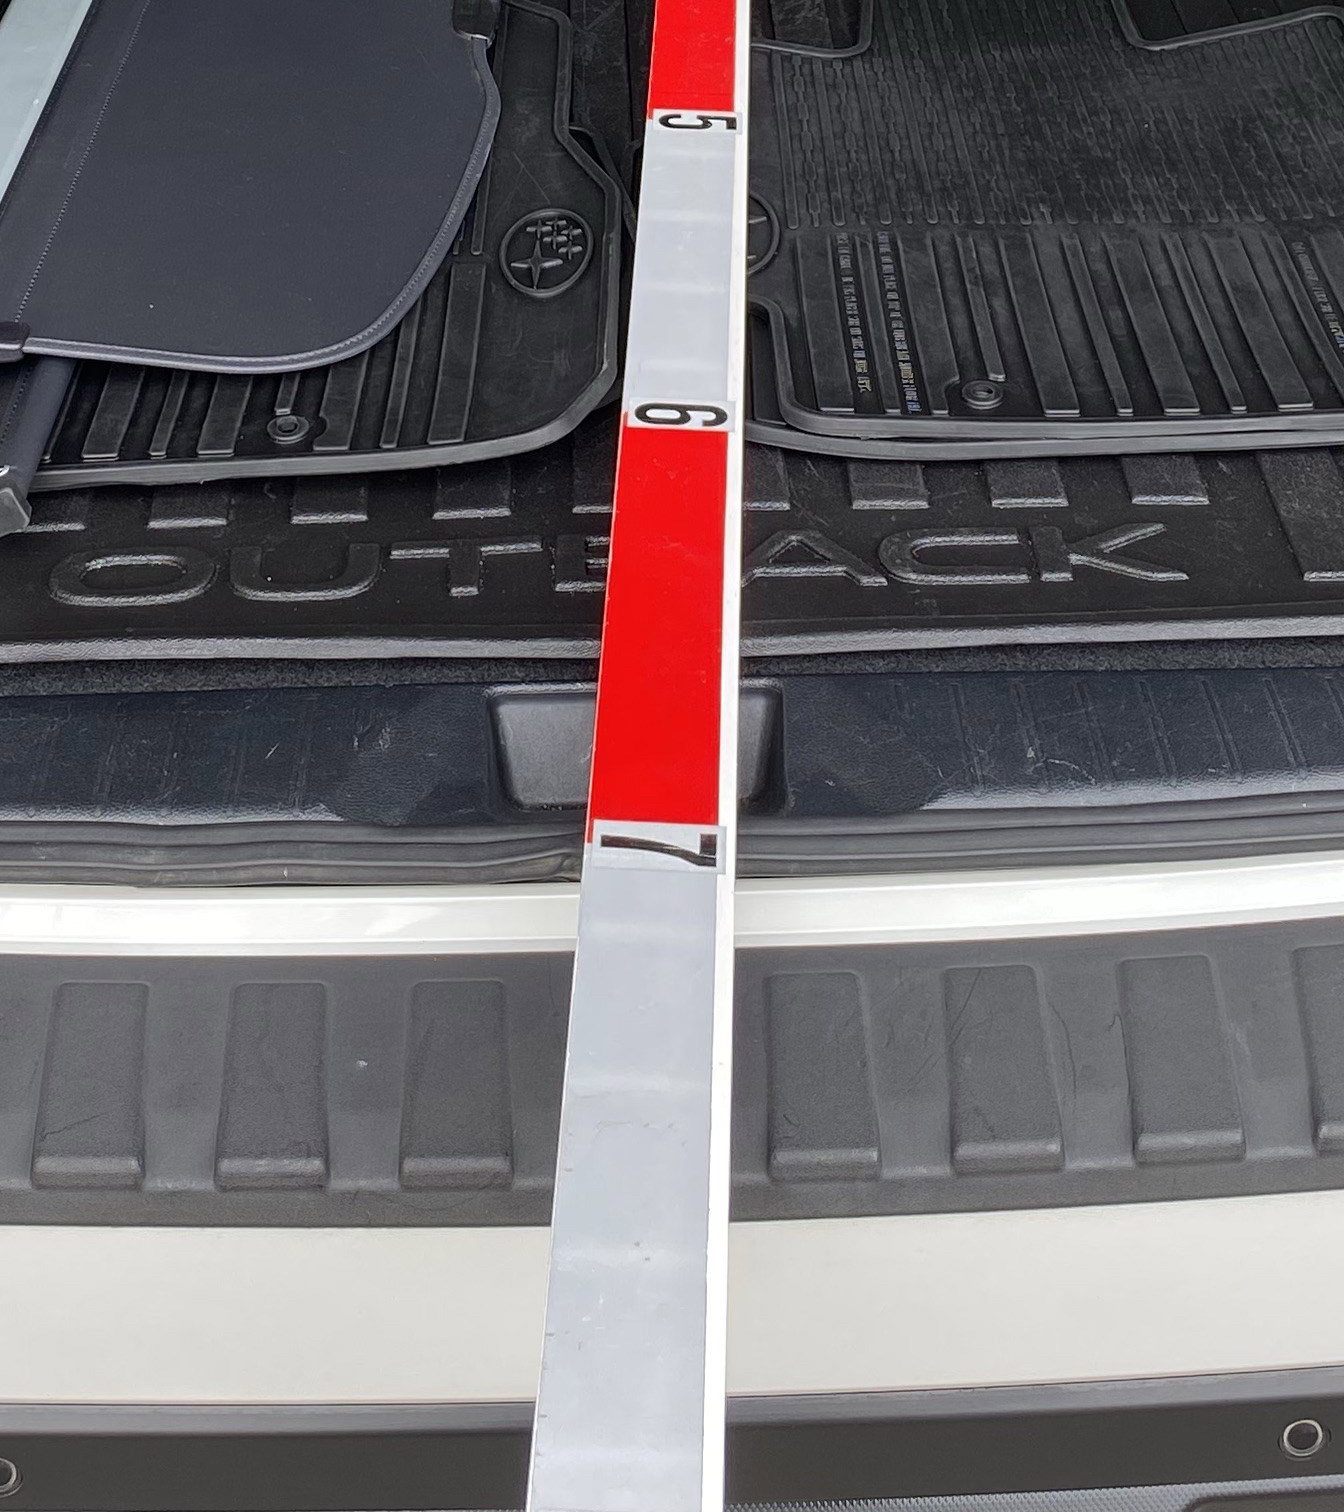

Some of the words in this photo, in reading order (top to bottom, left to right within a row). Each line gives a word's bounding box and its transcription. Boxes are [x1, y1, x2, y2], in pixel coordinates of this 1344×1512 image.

[659, 113, 738, 130] 5
[634, 402, 729, 427] 6
[600, 833, 718, 868] 7
